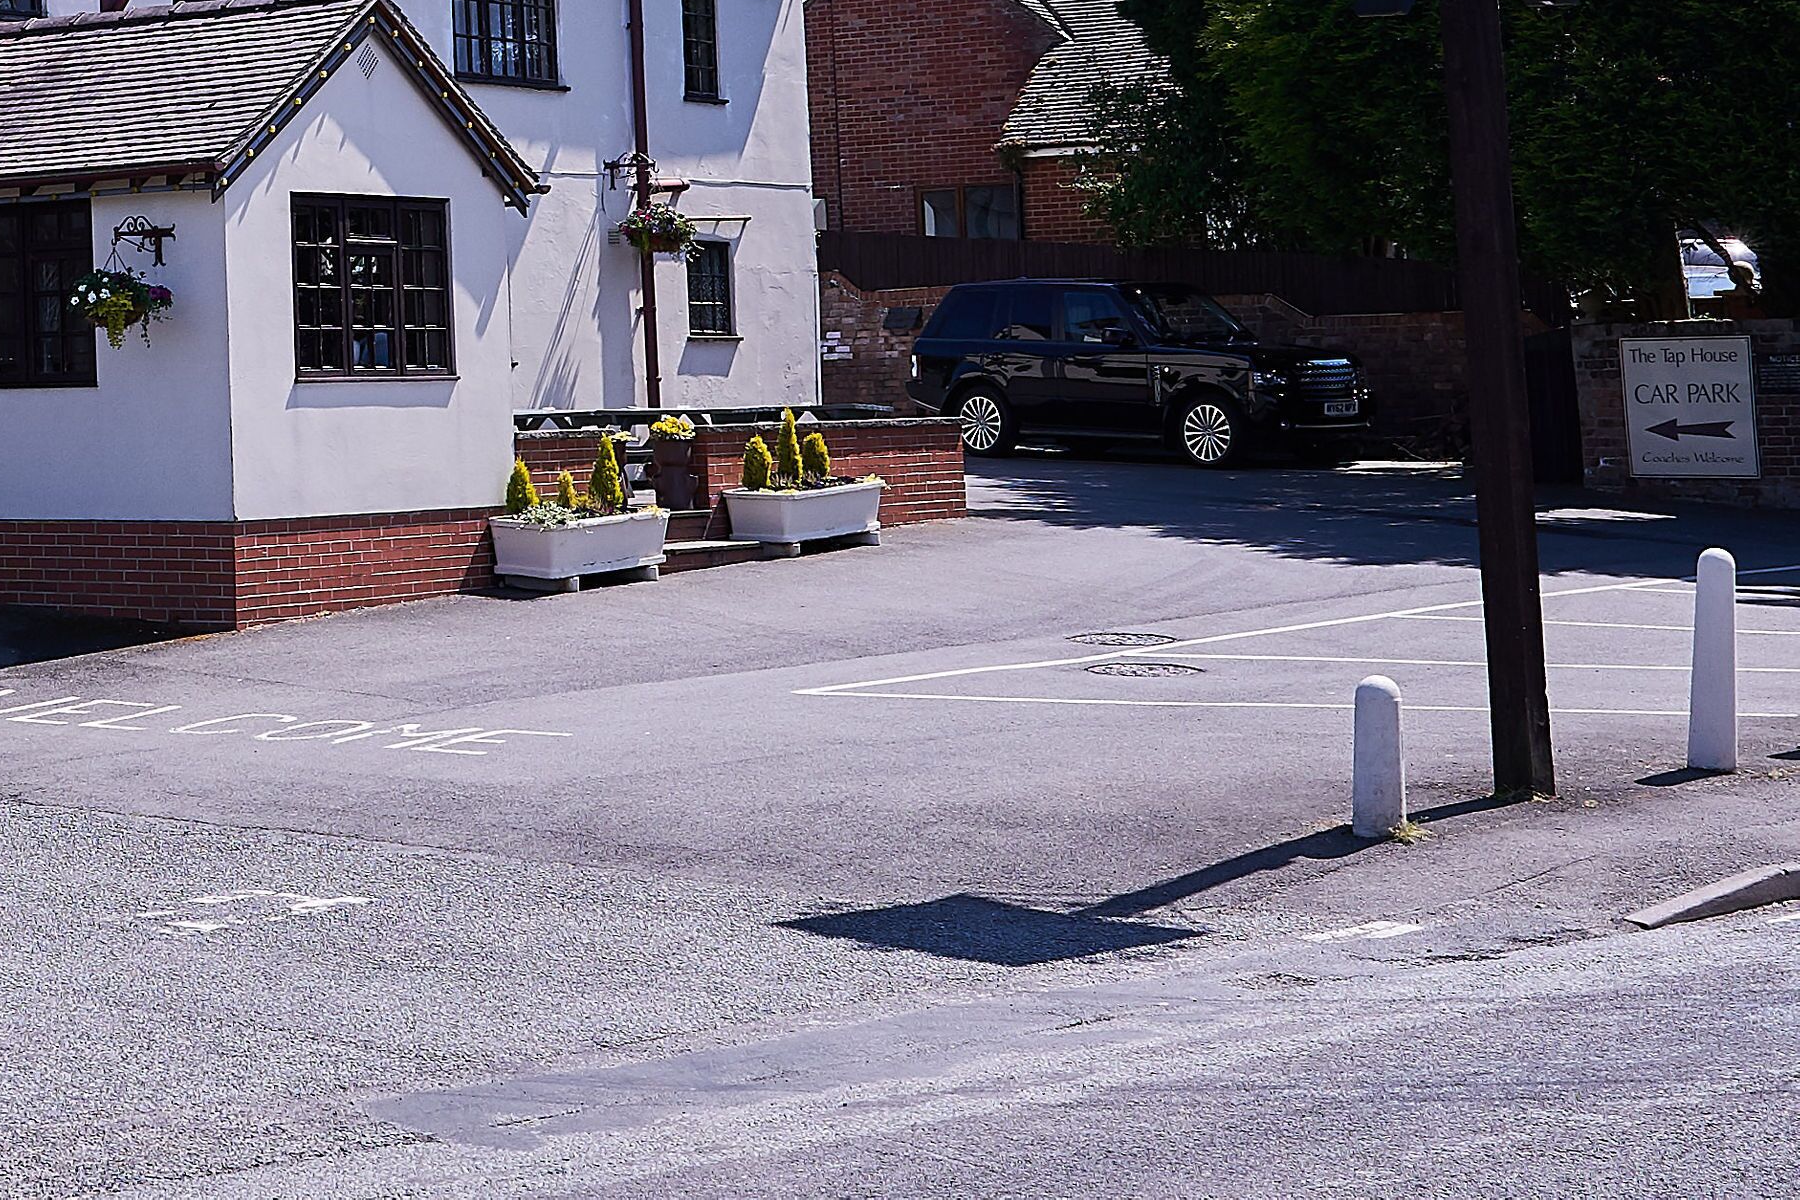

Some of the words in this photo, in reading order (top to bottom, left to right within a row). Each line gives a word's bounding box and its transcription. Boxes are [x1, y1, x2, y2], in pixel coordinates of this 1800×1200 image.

[1628, 349, 1656, 363] The
[1661, 349, 1685, 367] Tap
[1691, 348, 1738, 363] House
[1634, 384, 1680, 404] CAR
[1687, 383, 1741, 404] PARK
[1642, 452, 1691, 464] Coaches
[1693, 453, 1746, 464] Welcome
